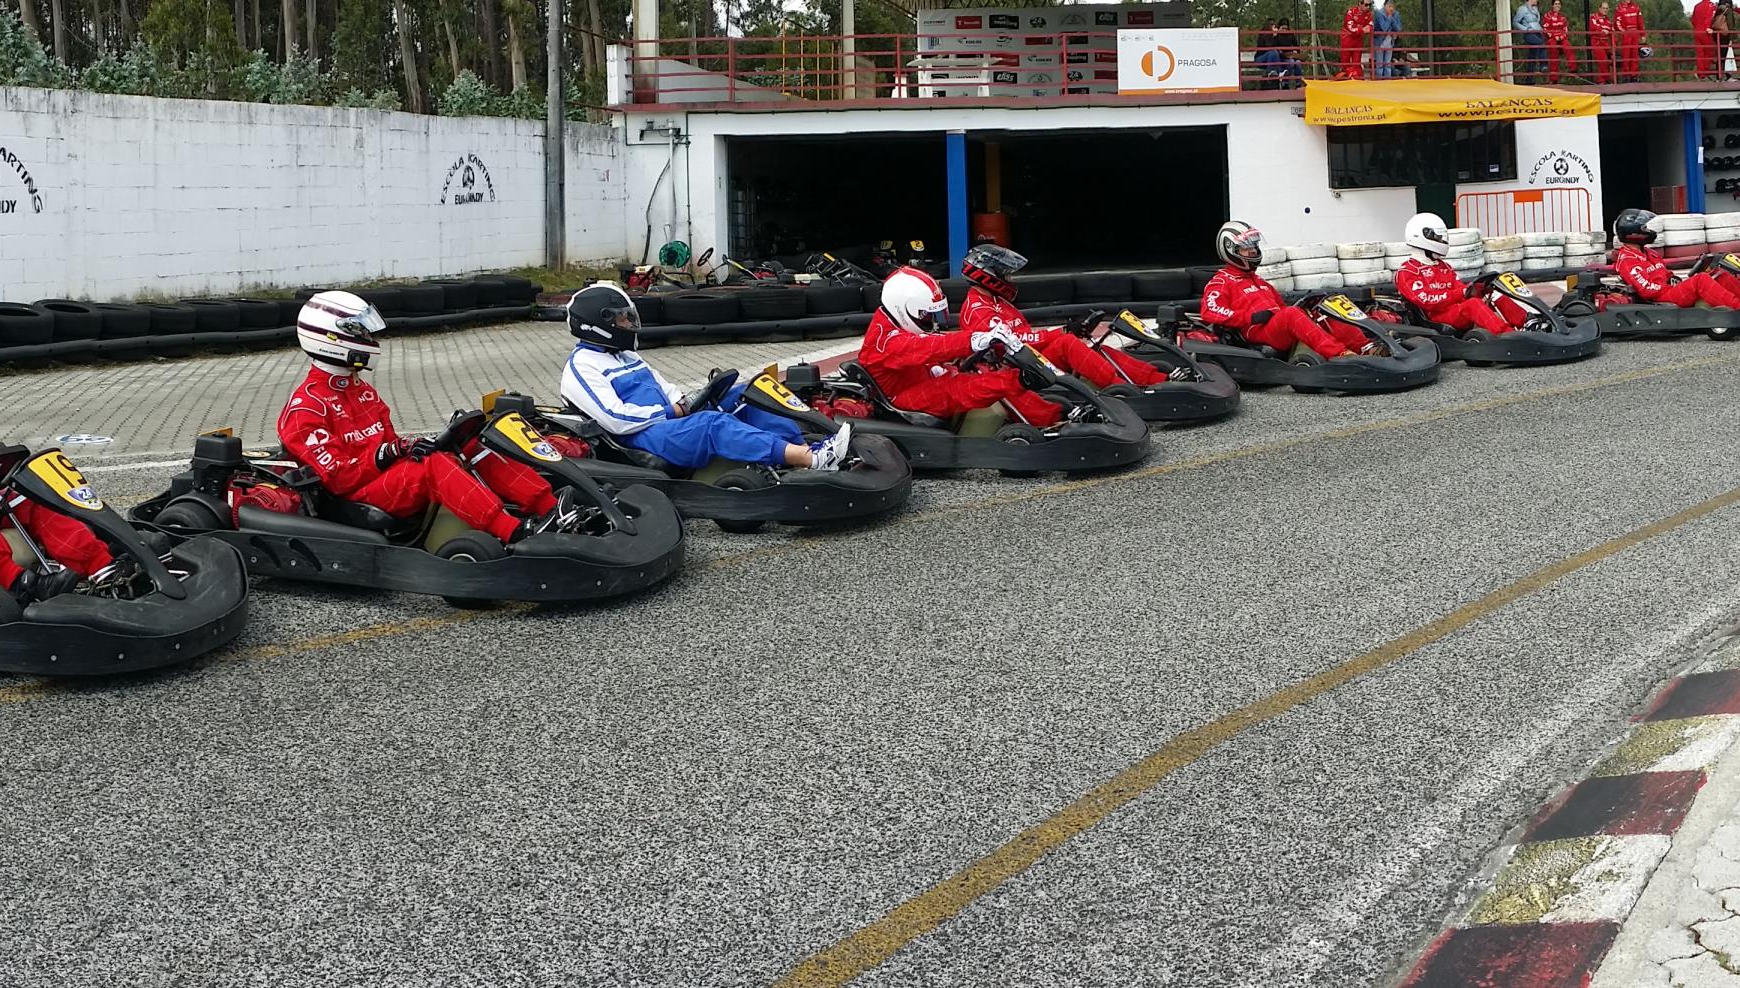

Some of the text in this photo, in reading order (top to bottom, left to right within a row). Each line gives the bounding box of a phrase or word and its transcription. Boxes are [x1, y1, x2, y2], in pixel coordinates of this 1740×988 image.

[1178, 59, 1217, 67] PRAGOSA
[467, 152, 496, 202] KARTING
[1527, 149, 1595, 185] ESCOLA KARTING
[1545, 176, 1580, 185] EUROINDY
[760, 376, 792, 399] 2
[509, 416, 546, 444] 2
[44, 454, 88, 489] 19
